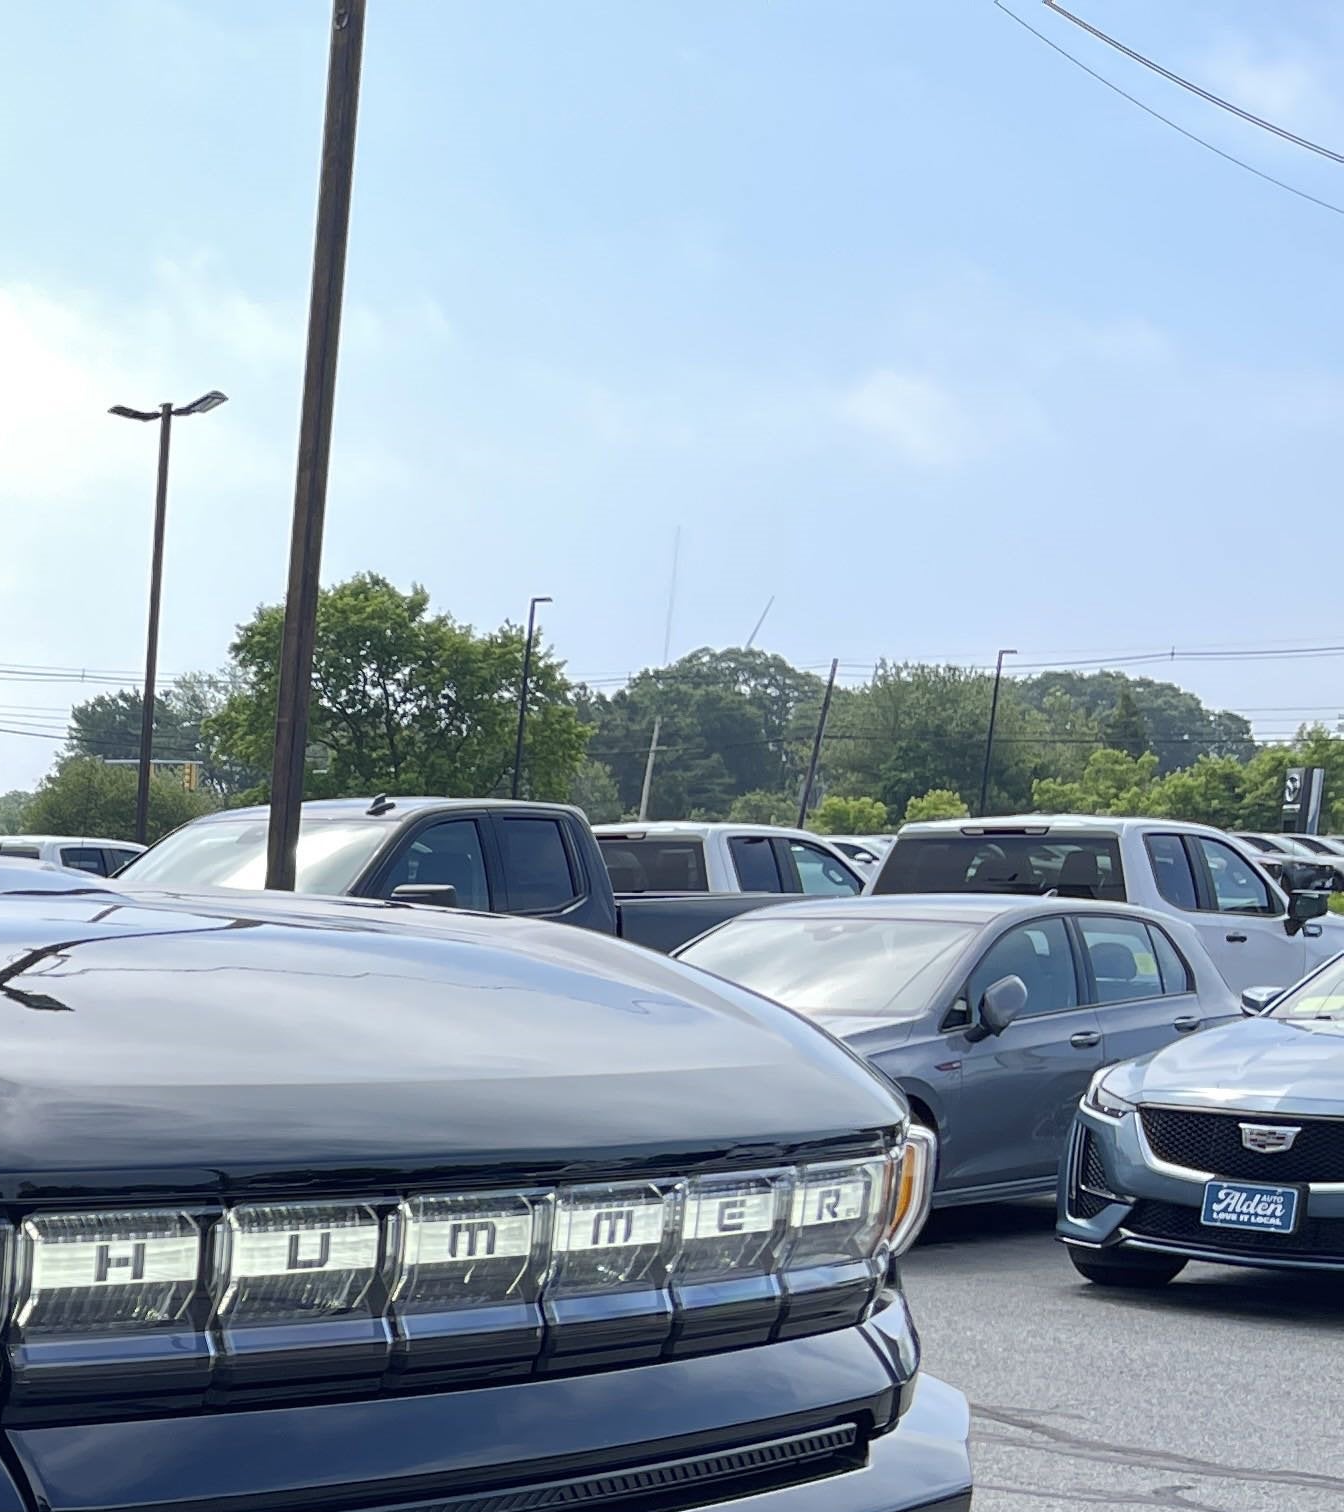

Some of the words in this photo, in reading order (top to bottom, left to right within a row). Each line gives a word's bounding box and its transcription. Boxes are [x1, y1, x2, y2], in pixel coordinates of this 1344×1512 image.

[1212, 1188, 1286, 1217] Alden
[1260, 1194, 1284, 1203] AUTO
[1212, 1211, 1238, 1221] LOVE
[1250, 1215, 1283, 1226] LOCAL
[94, 1188, 842, 1284] HUMMER
